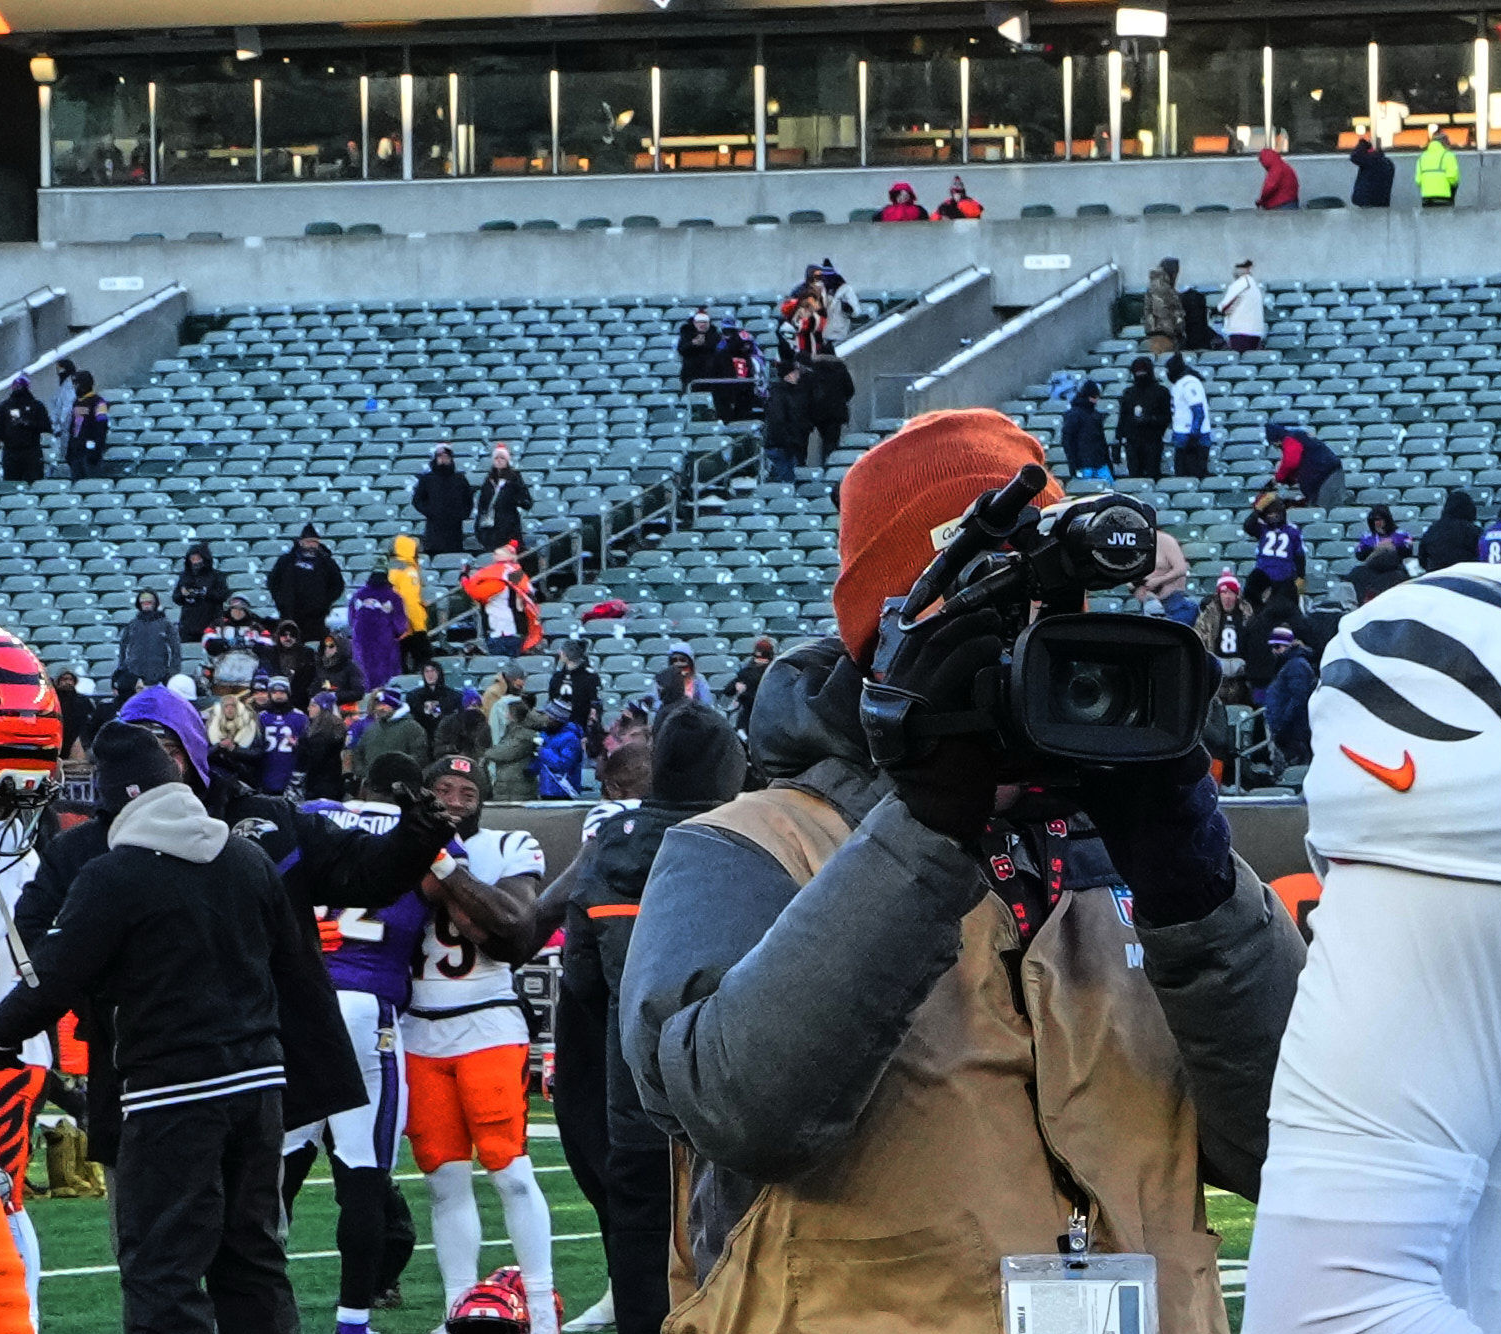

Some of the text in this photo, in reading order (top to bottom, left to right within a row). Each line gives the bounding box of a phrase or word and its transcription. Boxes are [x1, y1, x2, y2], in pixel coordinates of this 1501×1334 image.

[1107, 532, 1136, 546] JVC
[1262, 530, 1290, 558] 22
[1219, 628, 1238, 653] 8
[264, 726, 293, 753] 52
